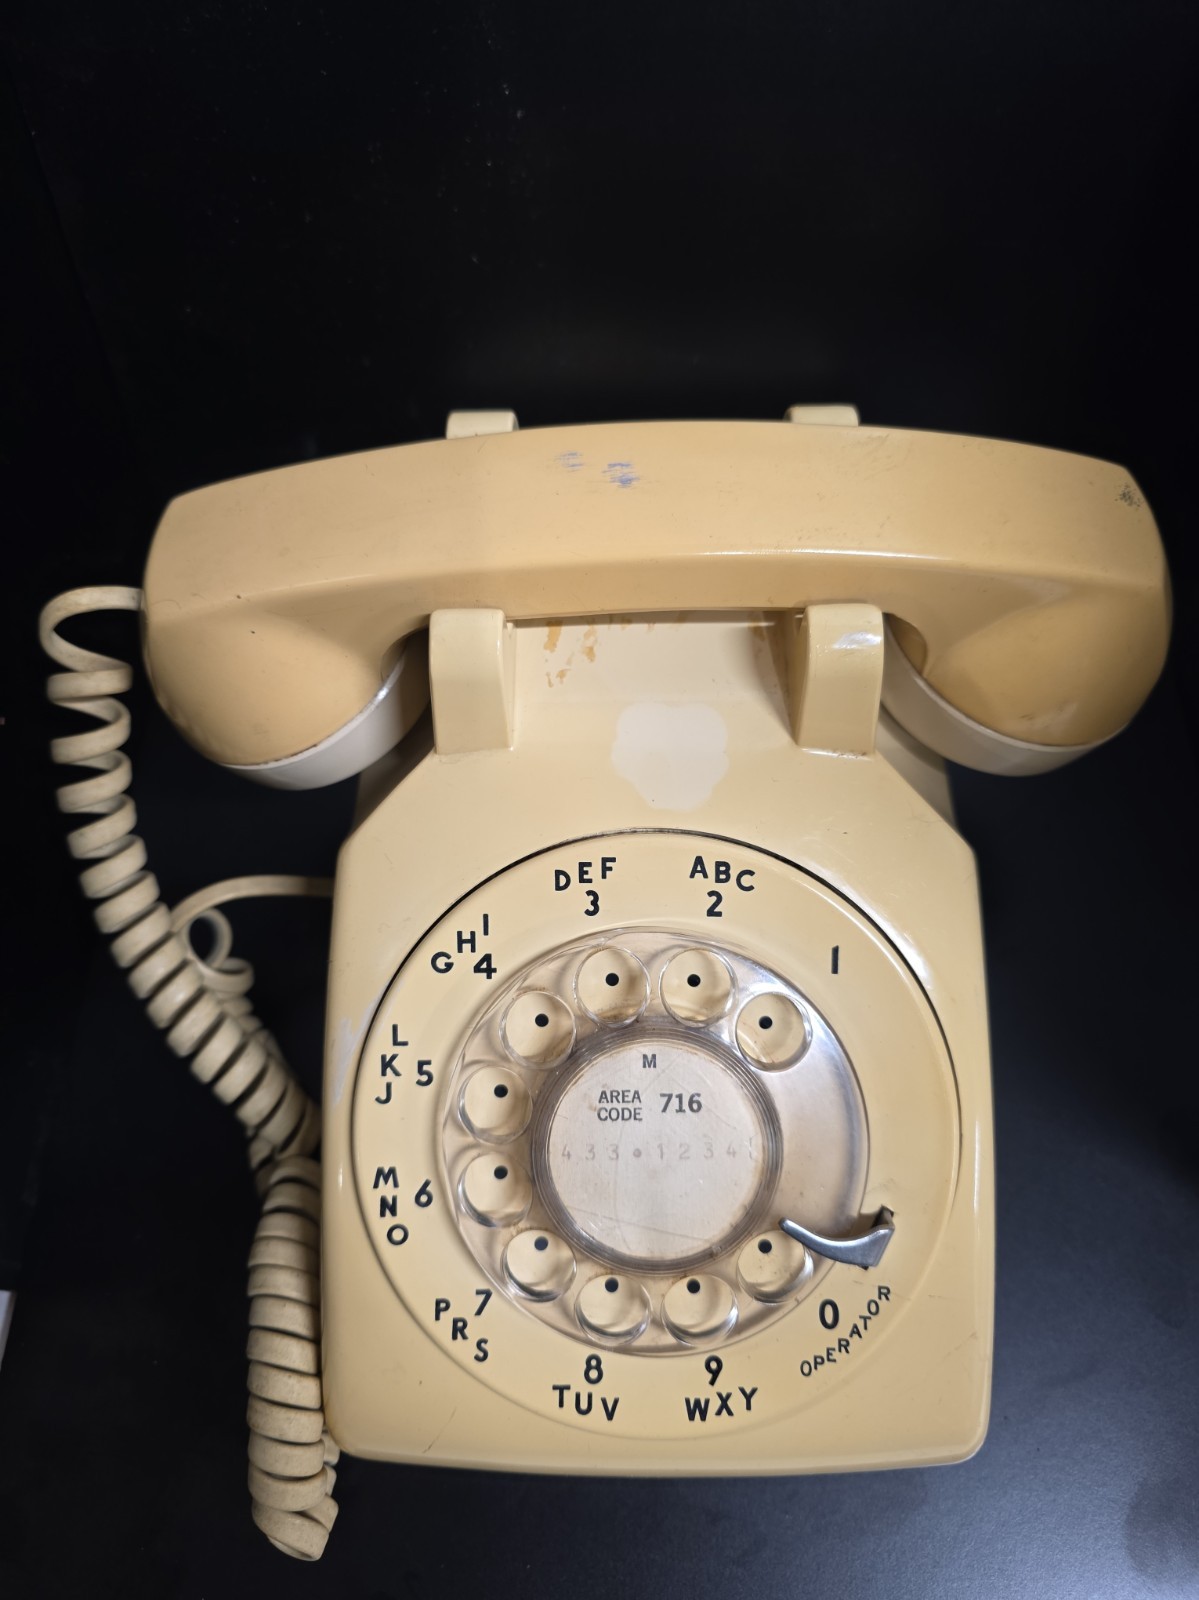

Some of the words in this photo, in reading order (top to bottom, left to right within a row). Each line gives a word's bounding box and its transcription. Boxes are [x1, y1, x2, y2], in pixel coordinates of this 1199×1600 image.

[554, 856, 617, 892] DEF
[688, 855, 756, 892] ABC
[583, 890, 600, 917] 3
[705, 890, 723, 918] 2
[473, 953, 498, 980] 4
[830, 944, 840, 975] 1
[415, 1059, 434, 1087] 5
[642, 1053, 657, 1069] M
[598, 1089, 642, 1104] AREA
[659, 1092, 703, 1114] 716
[597, 1106, 643, 1122] CODE
[414, 1178, 434, 1208] 6
[474, 1288, 493, 1317] 7
[799, 1284, 891, 1378] OPERATOR
[583, 1353, 604, 1386] 8
[704, 1354, 724, 1387] 9
[552, 1384, 620, 1422] TUV
[684, 1386, 759, 1423] WXY
